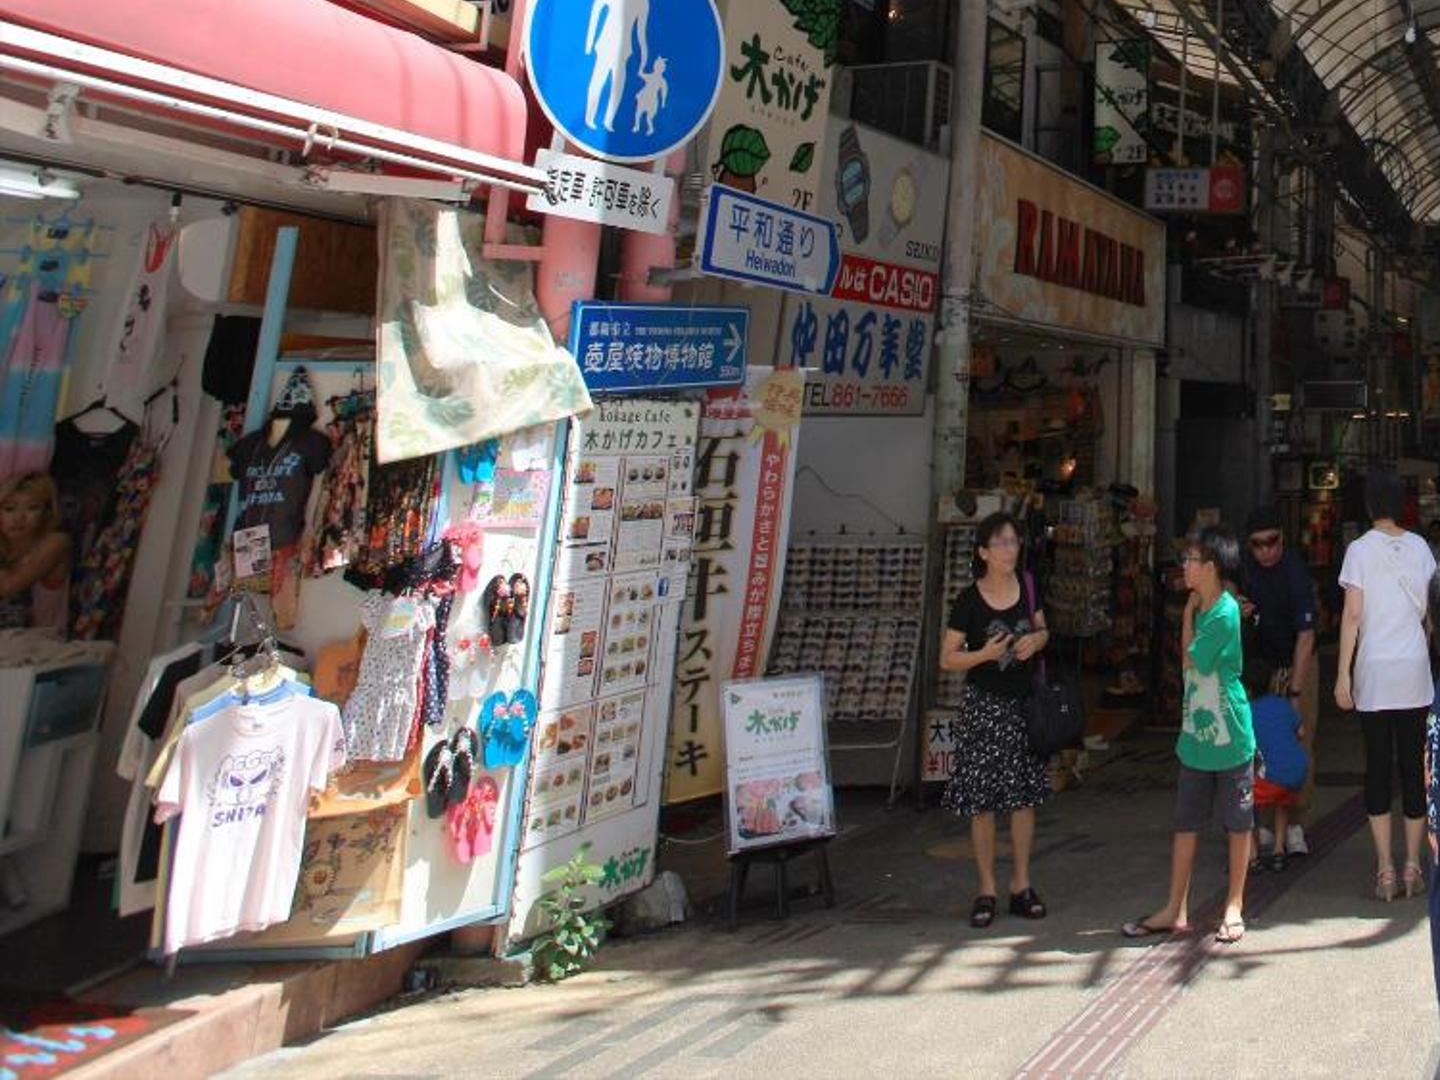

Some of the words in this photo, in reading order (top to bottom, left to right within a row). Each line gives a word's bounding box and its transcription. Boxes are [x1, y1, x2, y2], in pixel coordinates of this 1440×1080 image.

[731, 33, 826, 121] 木かげ
[729, 204, 816, 259] 平和通り
[745, 251, 796, 279] Heiwadori
[869, 265, 934, 309] CASIO
[584, 429, 677, 450] 木かげカフェ
